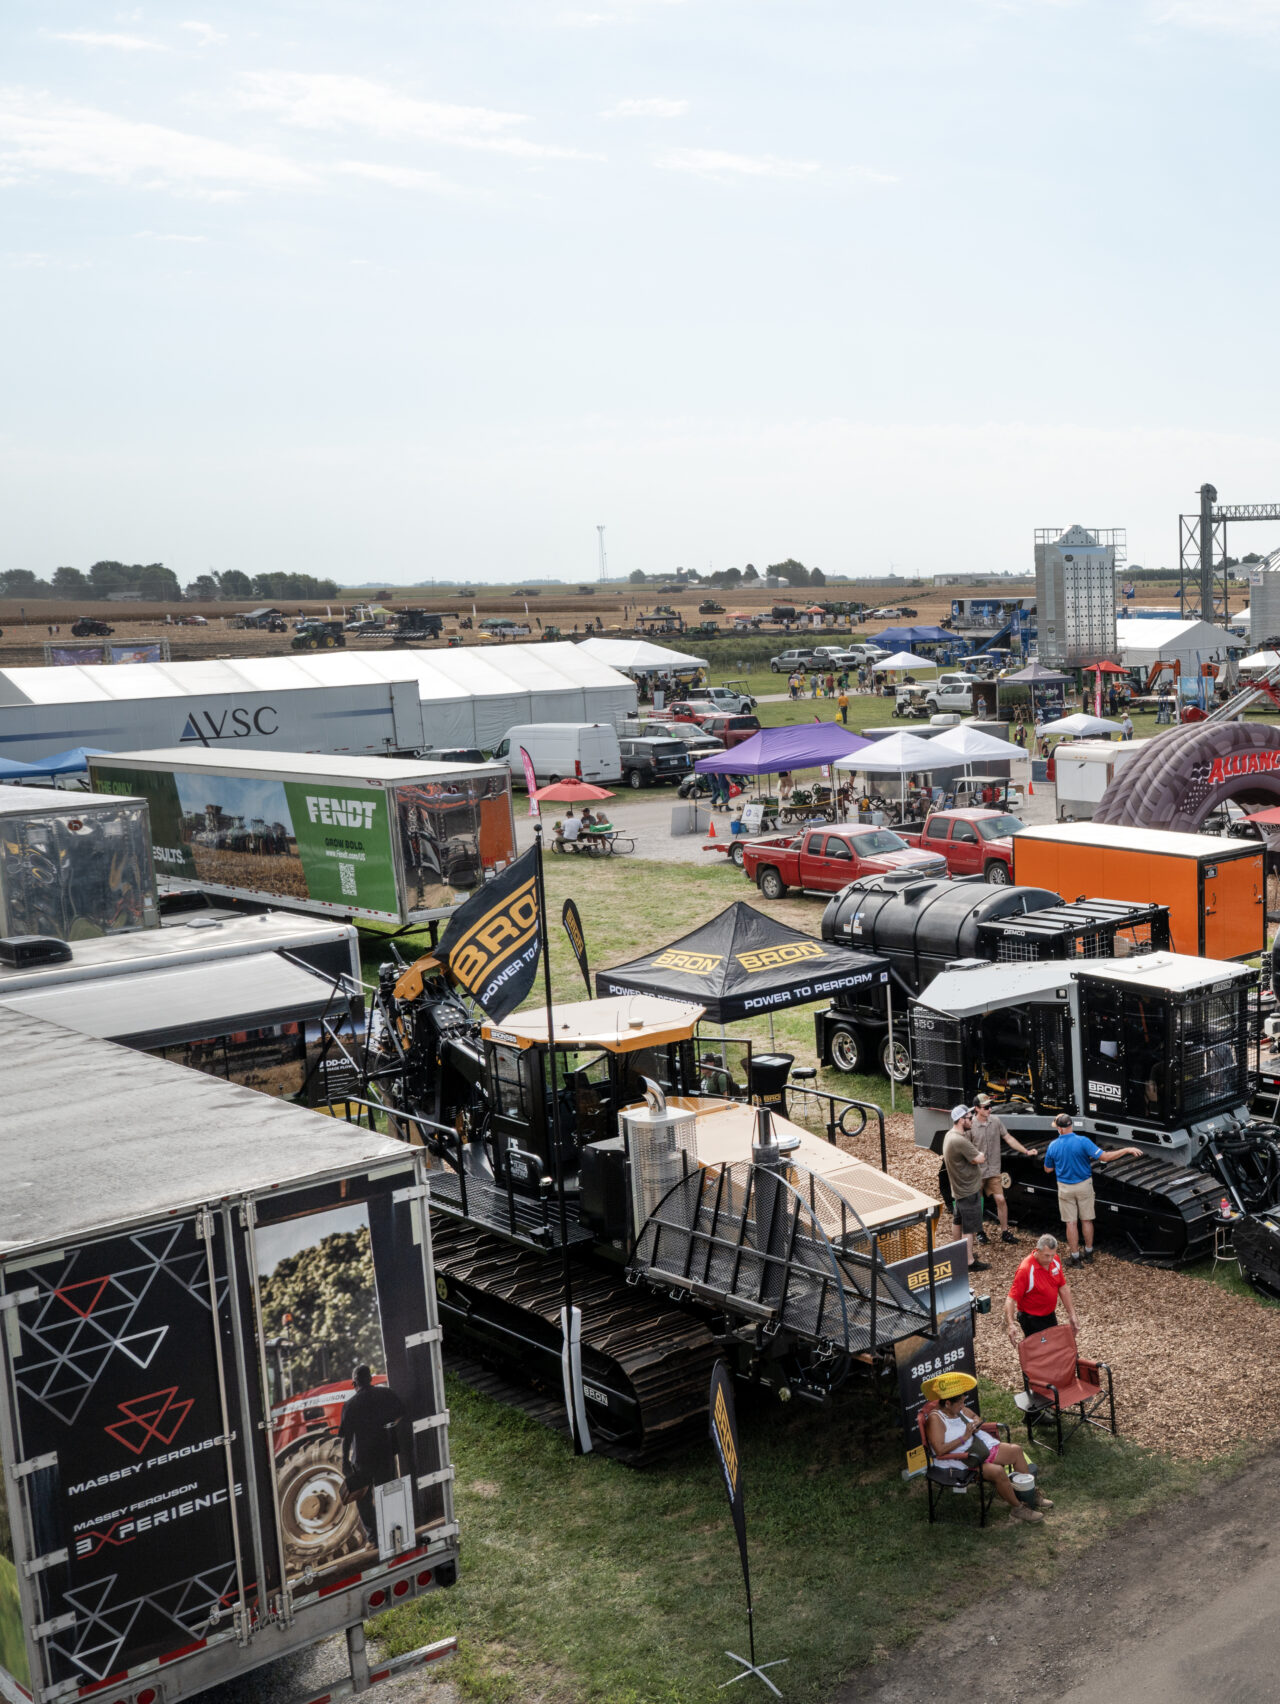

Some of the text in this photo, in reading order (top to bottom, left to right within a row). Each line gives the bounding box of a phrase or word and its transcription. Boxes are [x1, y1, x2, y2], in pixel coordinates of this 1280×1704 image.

[179, 706, 279, 748] AVSC
[305, 796, 377, 829] FENDT
[325, 837, 366, 851] GROW BOLD.
[453, 886, 539, 988] BRO
[657, 952, 721, 973] BRON
[737, 942, 826, 969] BRON
[481, 959, 524, 1005] POWER
[744, 973, 873, 1010] POWER TO PERFORM
[1088, 1082, 1121, 1096] BRON
[911, 1347, 965, 1379] 385 & 585
[942, 1363, 956, 1374] UNIT
[715, 1386, 738, 1490] BRON
[68, 1430, 237, 1496] MASSEY FERGUS
[73, 1481, 199, 1533] MASSEY FERGUSON
